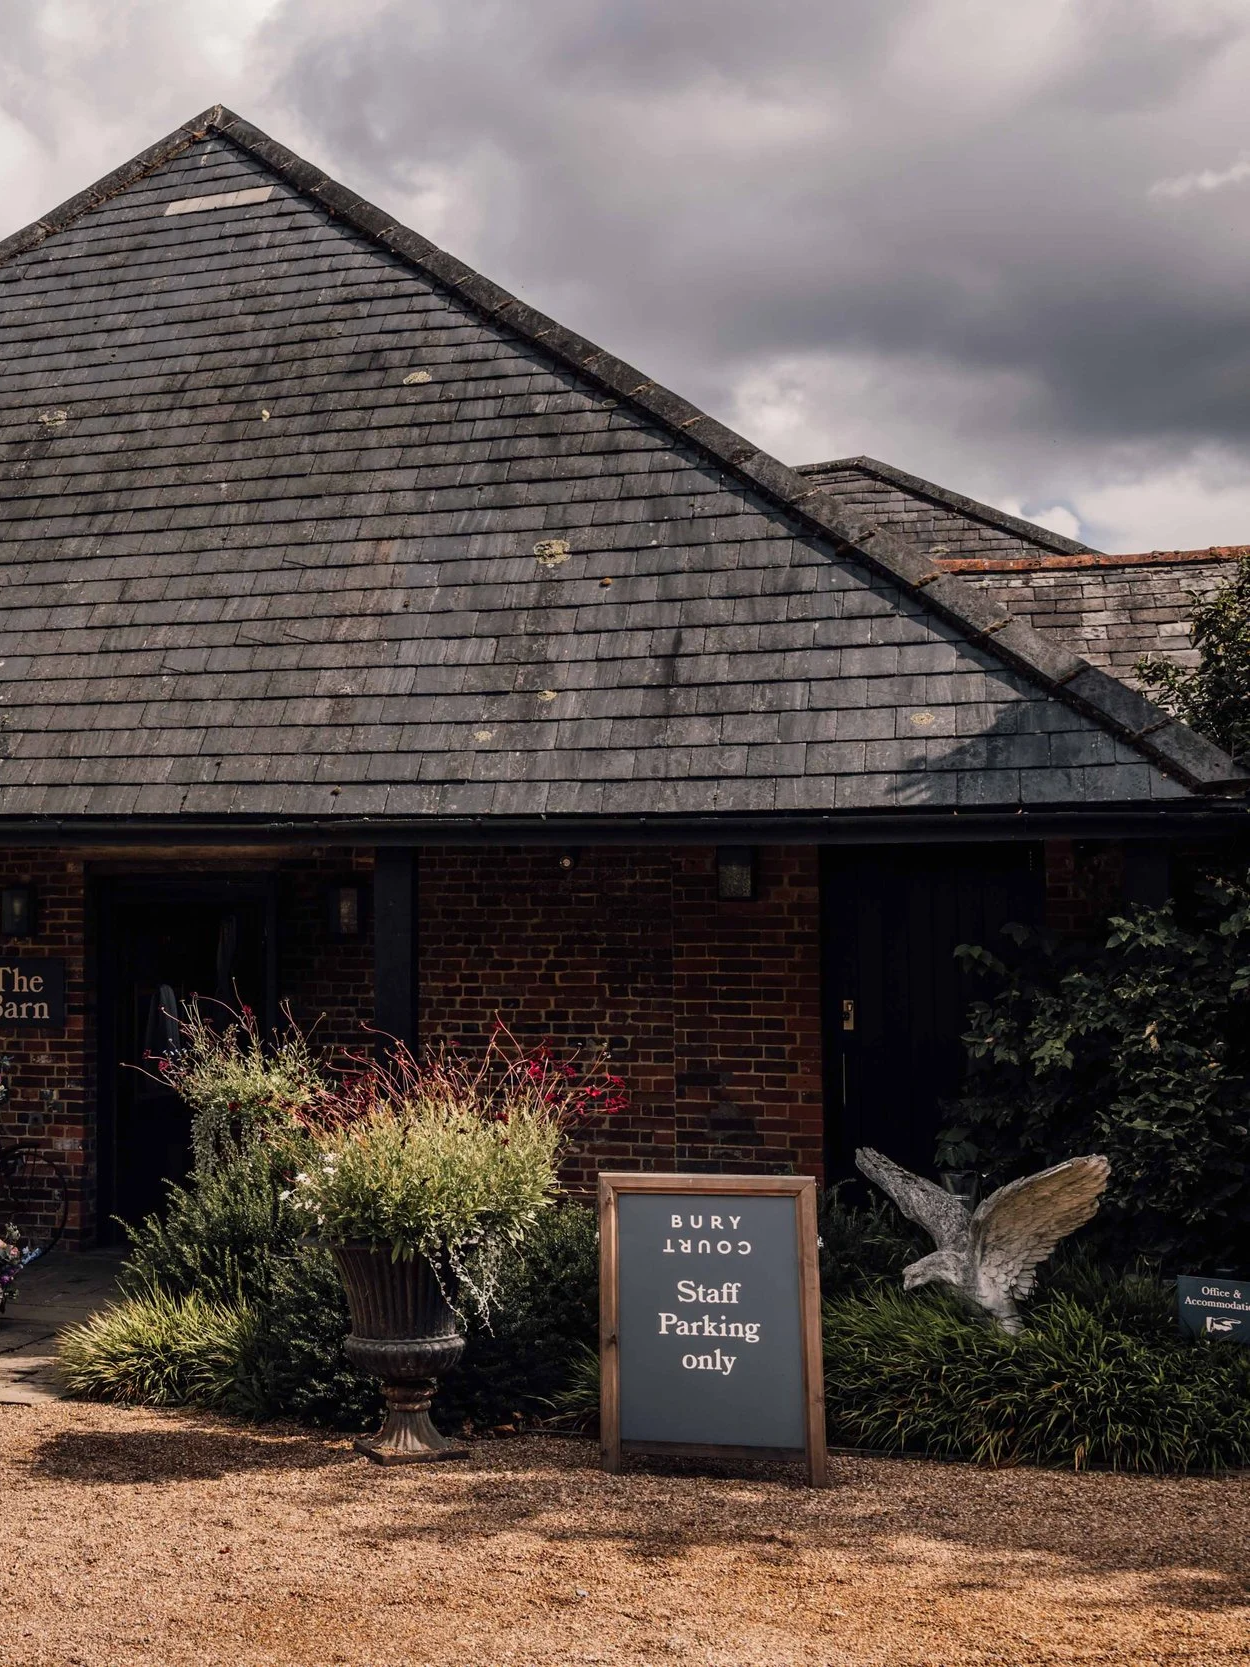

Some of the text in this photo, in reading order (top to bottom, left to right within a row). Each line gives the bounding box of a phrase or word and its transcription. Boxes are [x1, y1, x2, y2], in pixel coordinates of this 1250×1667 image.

[671, 1214, 741, 1230] BURY
[662, 1238, 752, 1255] COURT
[677, 1280, 742, 1304] Staff
[1201, 1286, 1242, 1299] Office &
[658, 1312, 761, 1343] Parking
[682, 1348, 737, 1376] only
